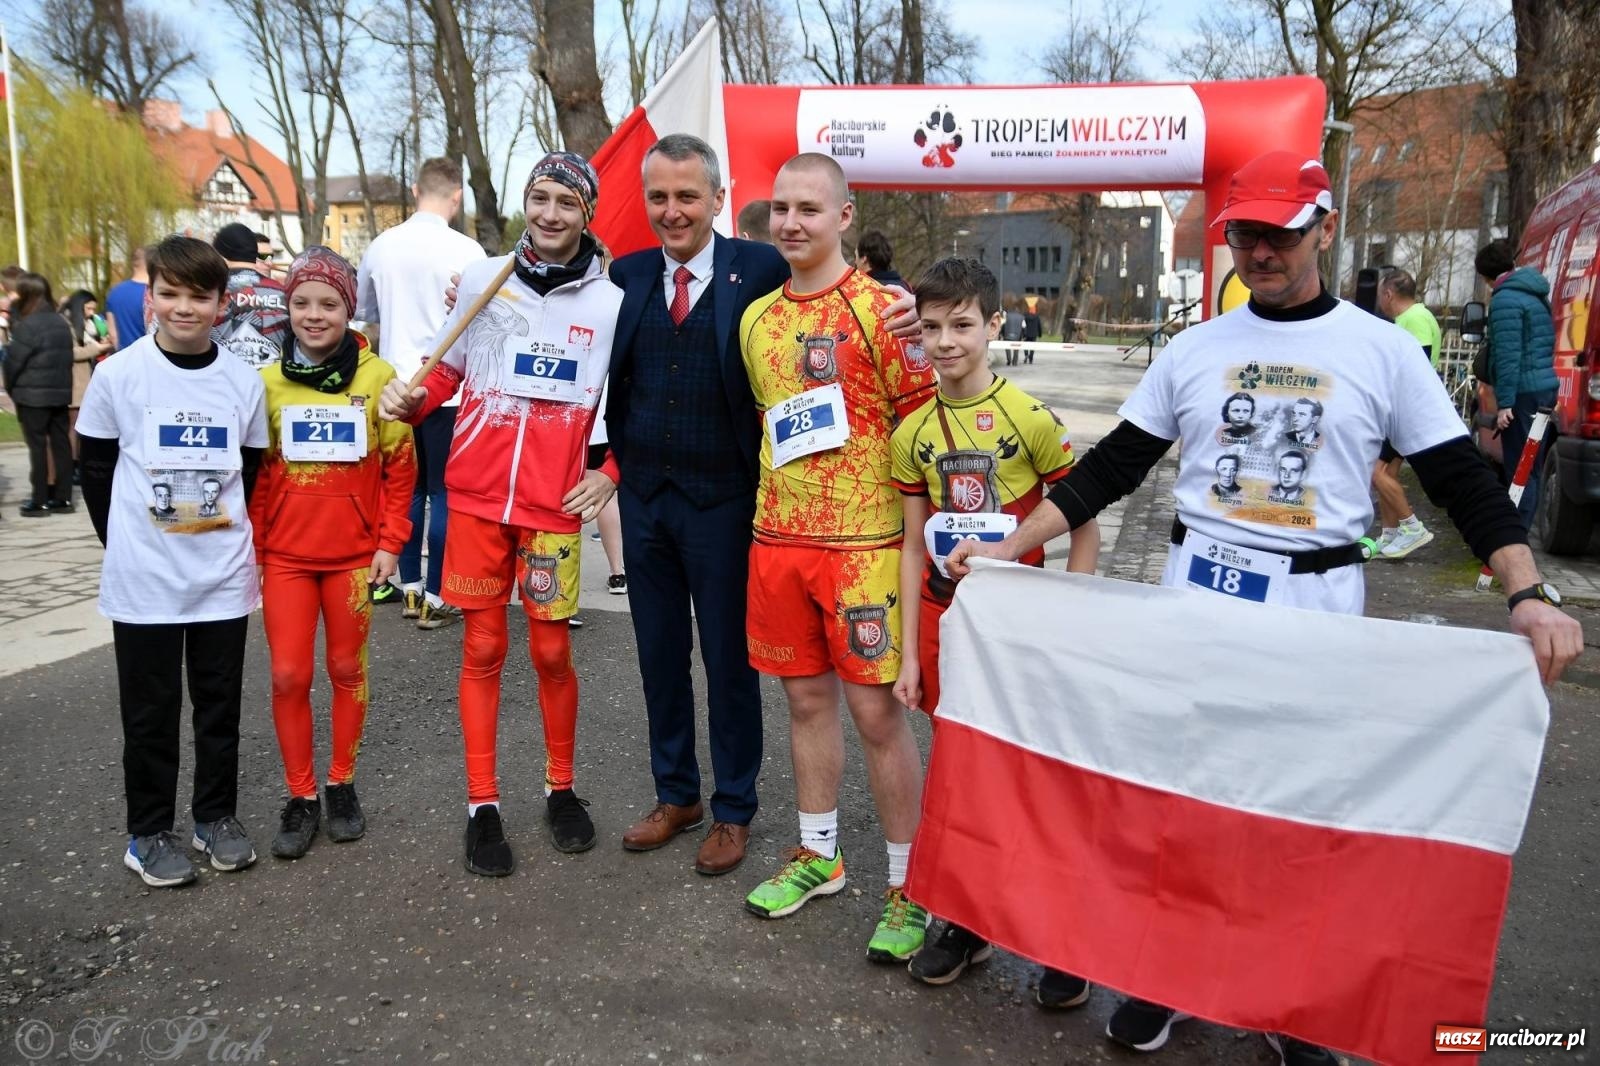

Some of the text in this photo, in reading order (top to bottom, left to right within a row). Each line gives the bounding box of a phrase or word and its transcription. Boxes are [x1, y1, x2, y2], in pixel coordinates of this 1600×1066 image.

[831, 119, 886, 131] Raciborskie
[831, 144, 865, 158] Kultury
[990, 147, 1167, 159] BIEG PAMIĘCI ŻOŁNIERZY WYKLĘTYCH
[236, 292, 287, 310] DYMEL
[532, 356, 561, 377] 67
[1266, 365, 1294, 374] TROPEM
[1265, 374, 1318, 389] WILCZYM
[788, 409, 814, 436] 28
[179, 426, 209, 446] 44
[308, 422, 333, 441] 21
[957, 521, 986, 529] WILCZYM
[1291, 515, 1312, 526] 2024
[1220, 551, 1252, 567] WILCZYM
[1210, 565, 1242, 593] 18
